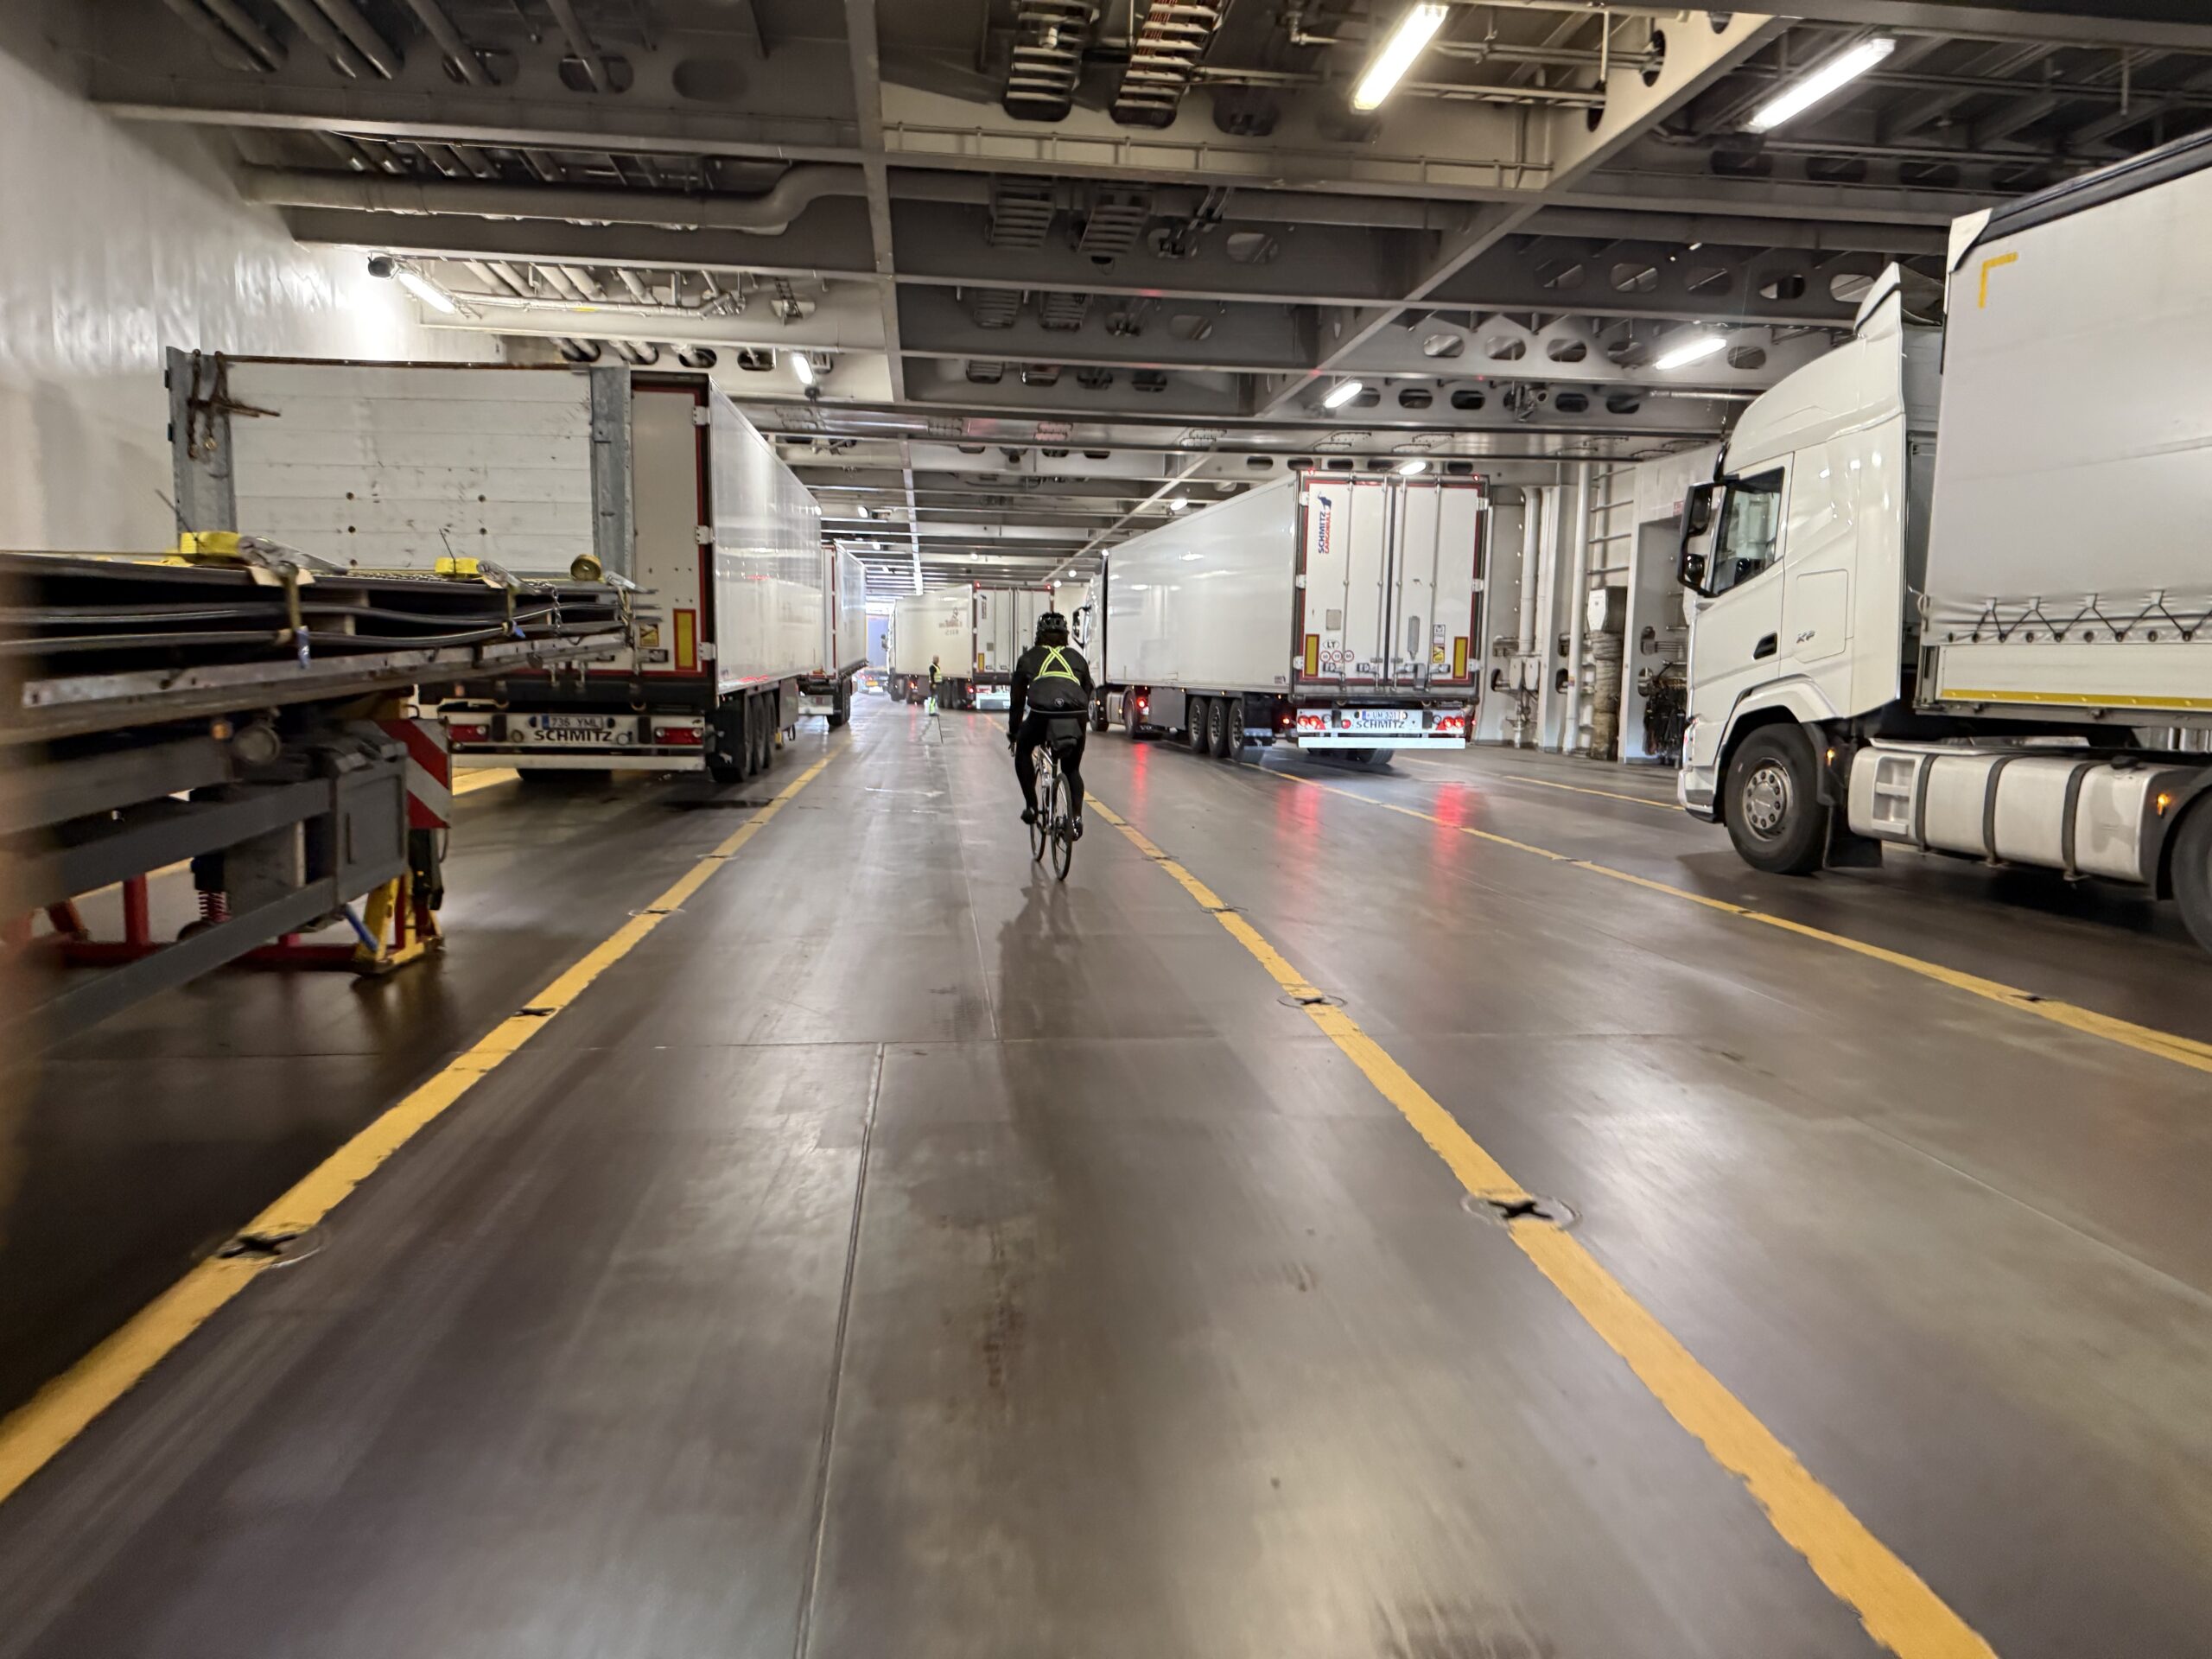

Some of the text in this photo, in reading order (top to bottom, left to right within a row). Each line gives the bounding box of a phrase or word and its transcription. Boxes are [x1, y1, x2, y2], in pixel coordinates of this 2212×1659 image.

[1318, 511, 1326, 554] SCHMITZ
[1356, 719, 1406, 729] SCHMITZ
[533, 728, 613, 742] SCHMITZ
